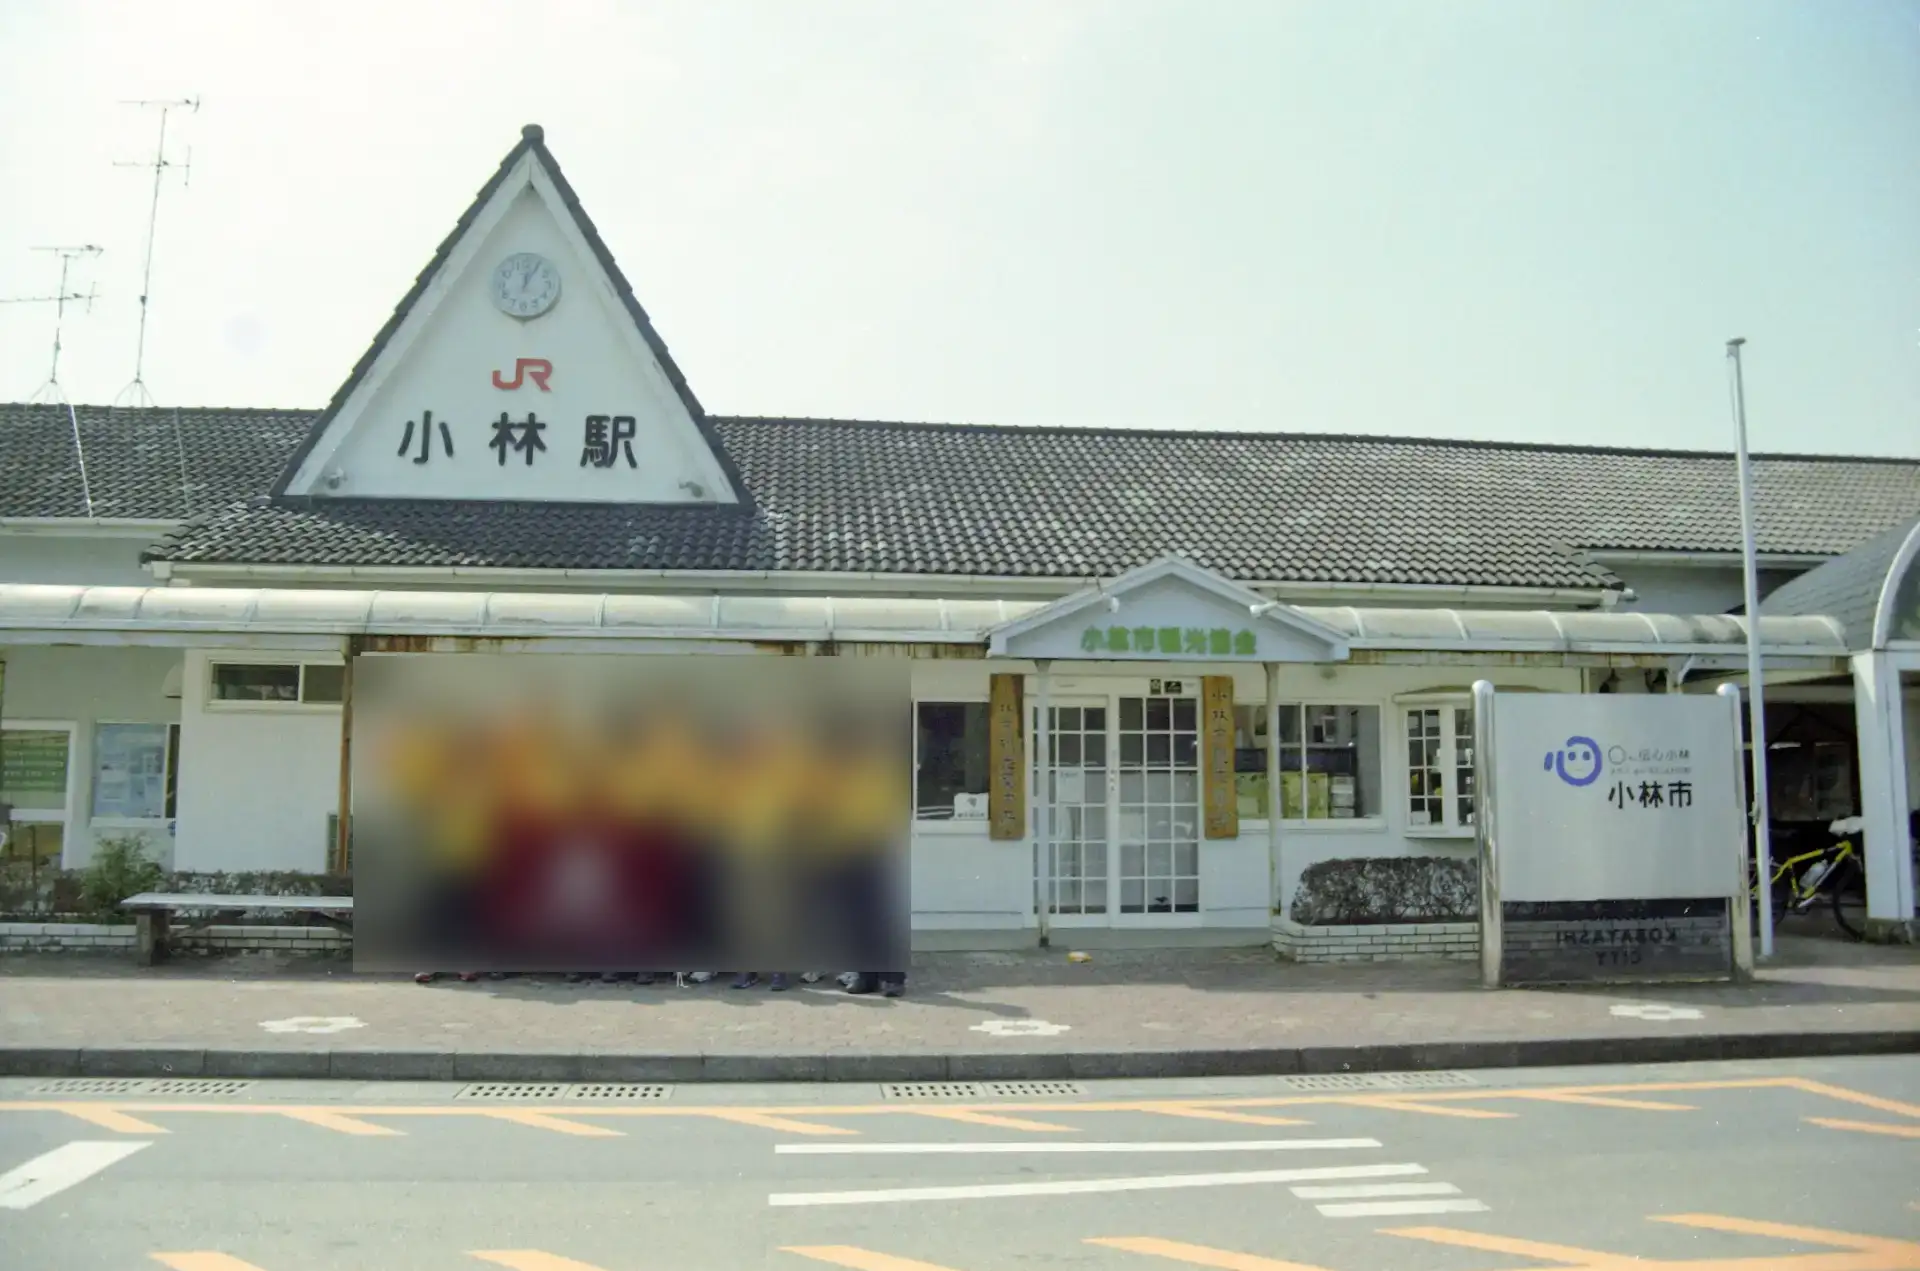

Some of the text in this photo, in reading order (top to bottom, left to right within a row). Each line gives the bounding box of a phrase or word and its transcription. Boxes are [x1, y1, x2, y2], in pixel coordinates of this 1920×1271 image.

[492, 358, 553, 391] JR
[397, 410, 638, 468] 小林駅
[1608, 780, 1692, 809] 小林市
